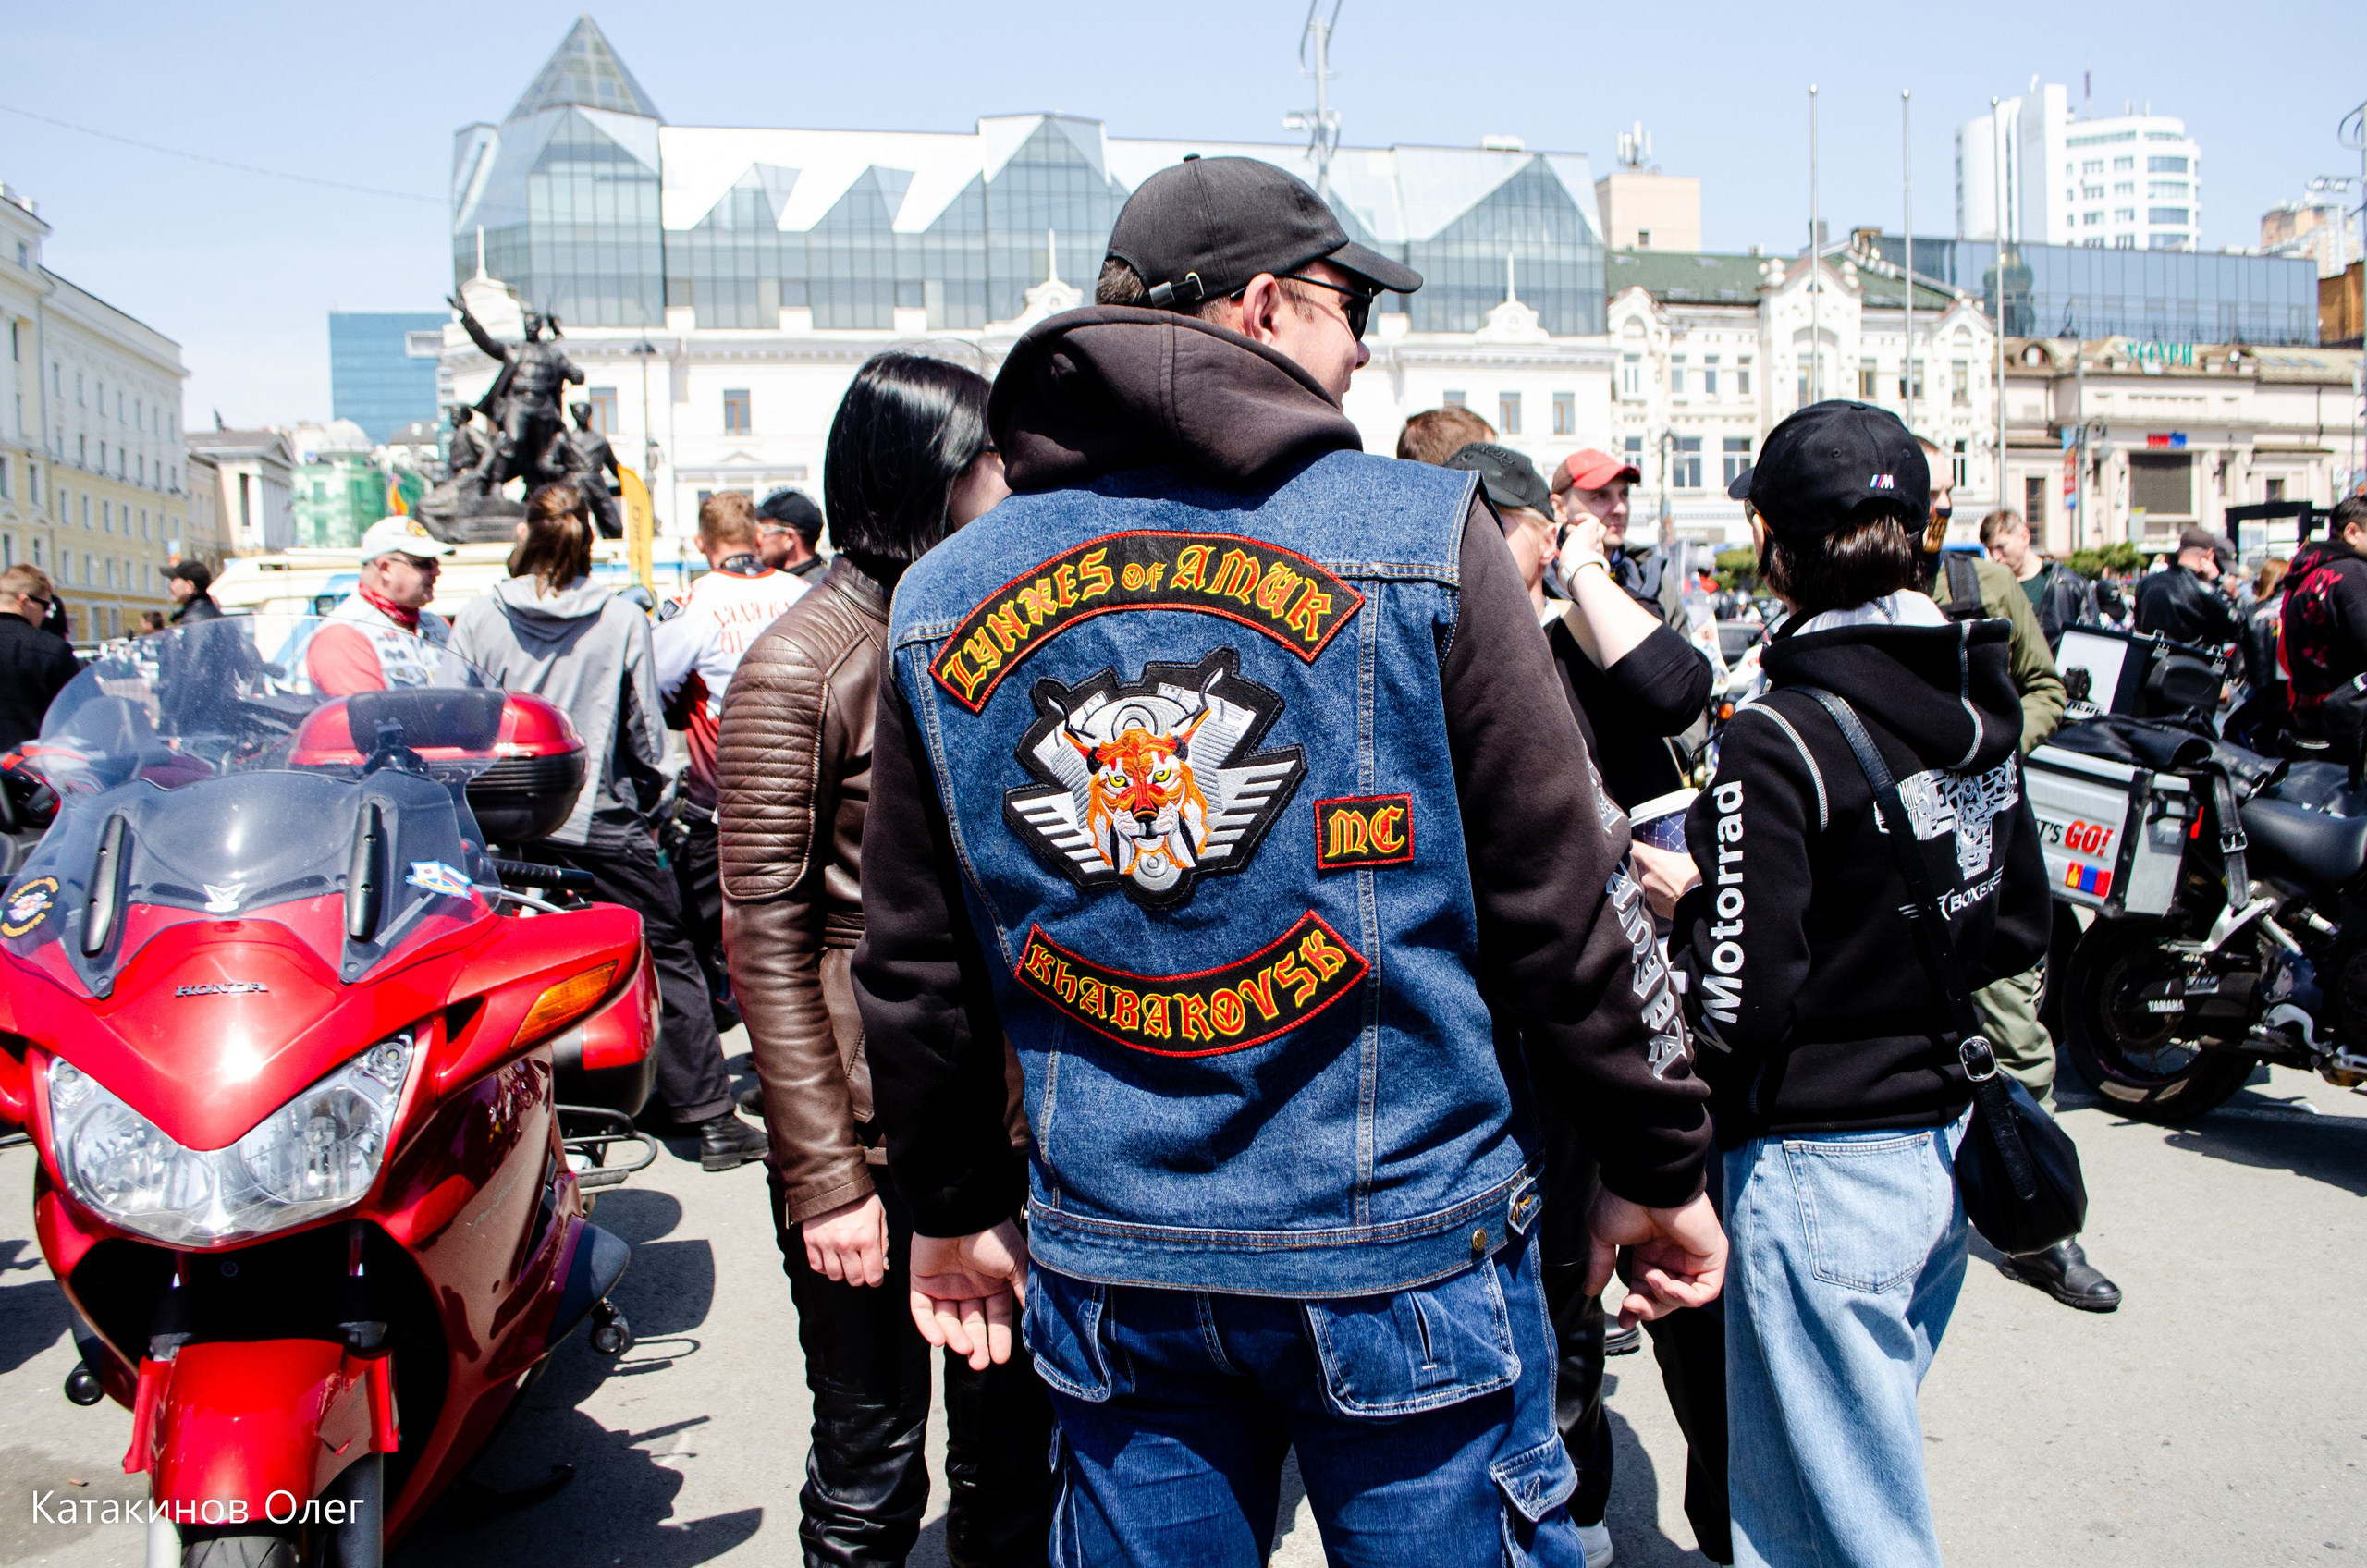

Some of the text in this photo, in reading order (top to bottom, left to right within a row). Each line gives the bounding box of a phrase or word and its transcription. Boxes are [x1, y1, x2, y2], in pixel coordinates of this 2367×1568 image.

[943, 544, 1332, 701] LYNXES OF AMUR
[1327, 804, 1406, 859] MC
[2035, 818, 2115, 859] T'S GO!
[1701, 779, 1745, 1024] Motorrad
[1950, 876, 1995, 913] BOXER
[175, 981, 269, 998] HONDA
[1024, 927, 1350, 1042] KHABAROVSK
[2148, 999, 2185, 1013] YAMAHA
